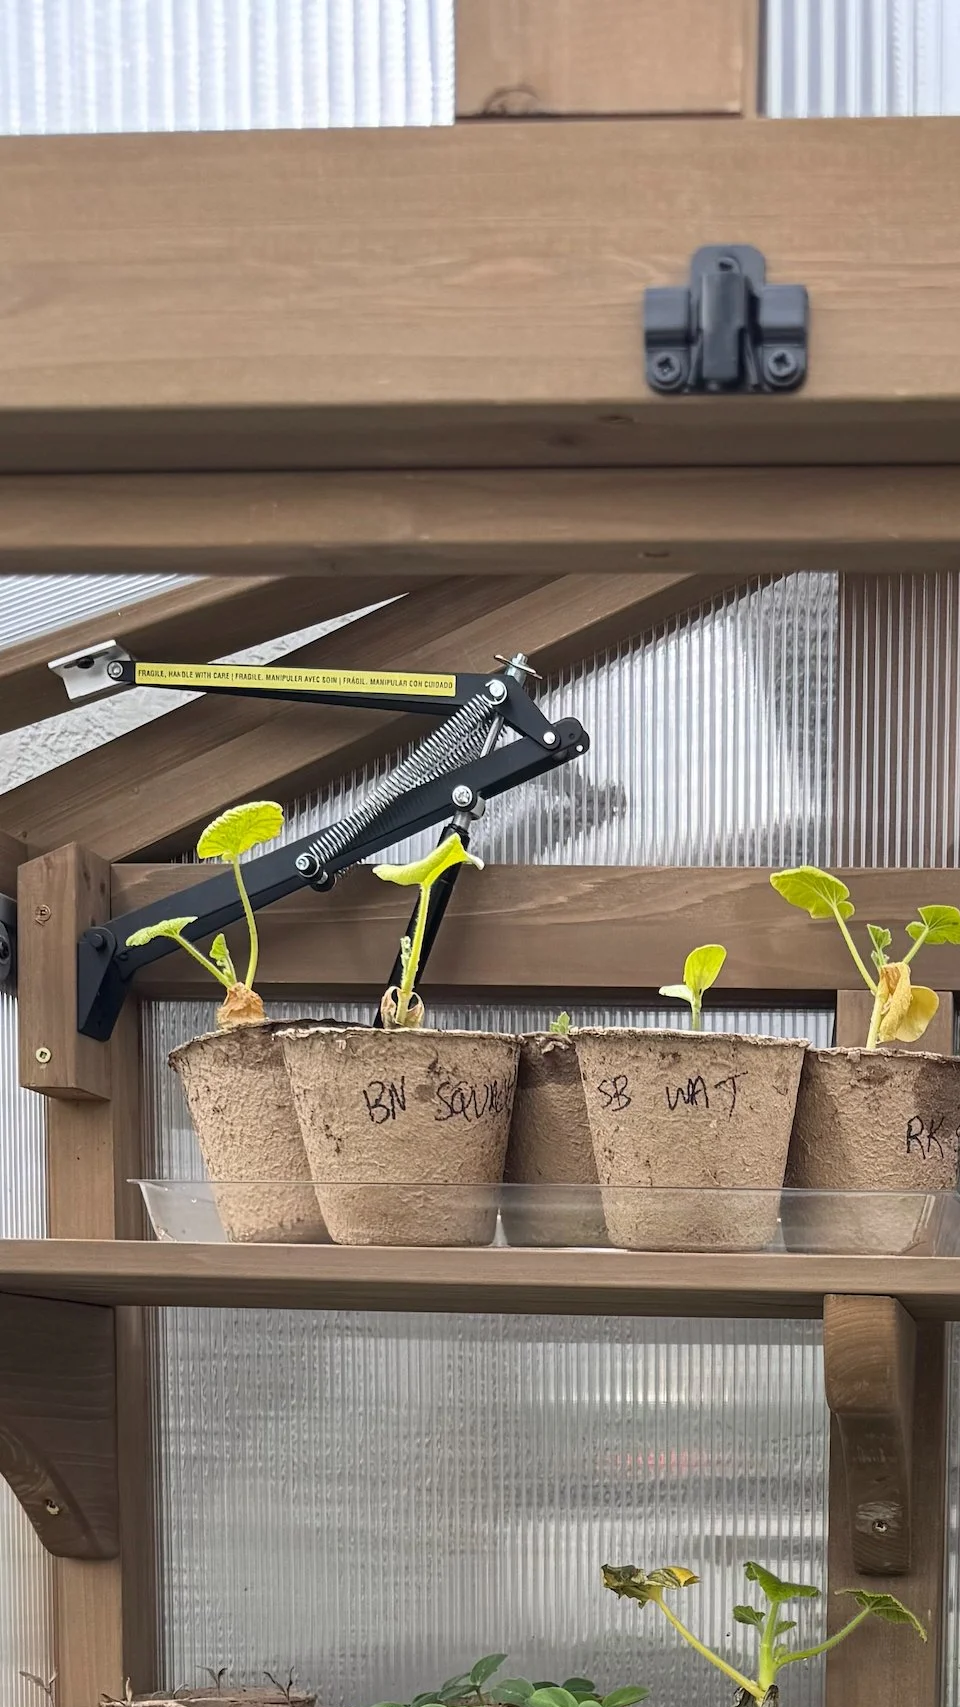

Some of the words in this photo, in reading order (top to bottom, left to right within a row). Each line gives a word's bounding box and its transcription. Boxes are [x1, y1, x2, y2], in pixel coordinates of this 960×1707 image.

[138, 669, 167, 679] FRAGILE,
[168, 670, 193, 679] HANDLE
[195, 671, 212, 679] WITH
[213, 672, 230, 680] CARE
[265, 674, 303, 682] MANIPULER
[304, 675, 320, 683] AVEC
[322, 676, 337, 684] SOIN
[370, 678, 408, 687] MANIPULAR
[409, 680, 423, 688] CON
[424, 681, 453, 689] CUIDADO
[362, 1075, 407, 1125] BN
[597, 1074, 632, 1112] SB
[665, 1070, 749, 1119] WAT
[906, 1114, 945, 1160] RK
